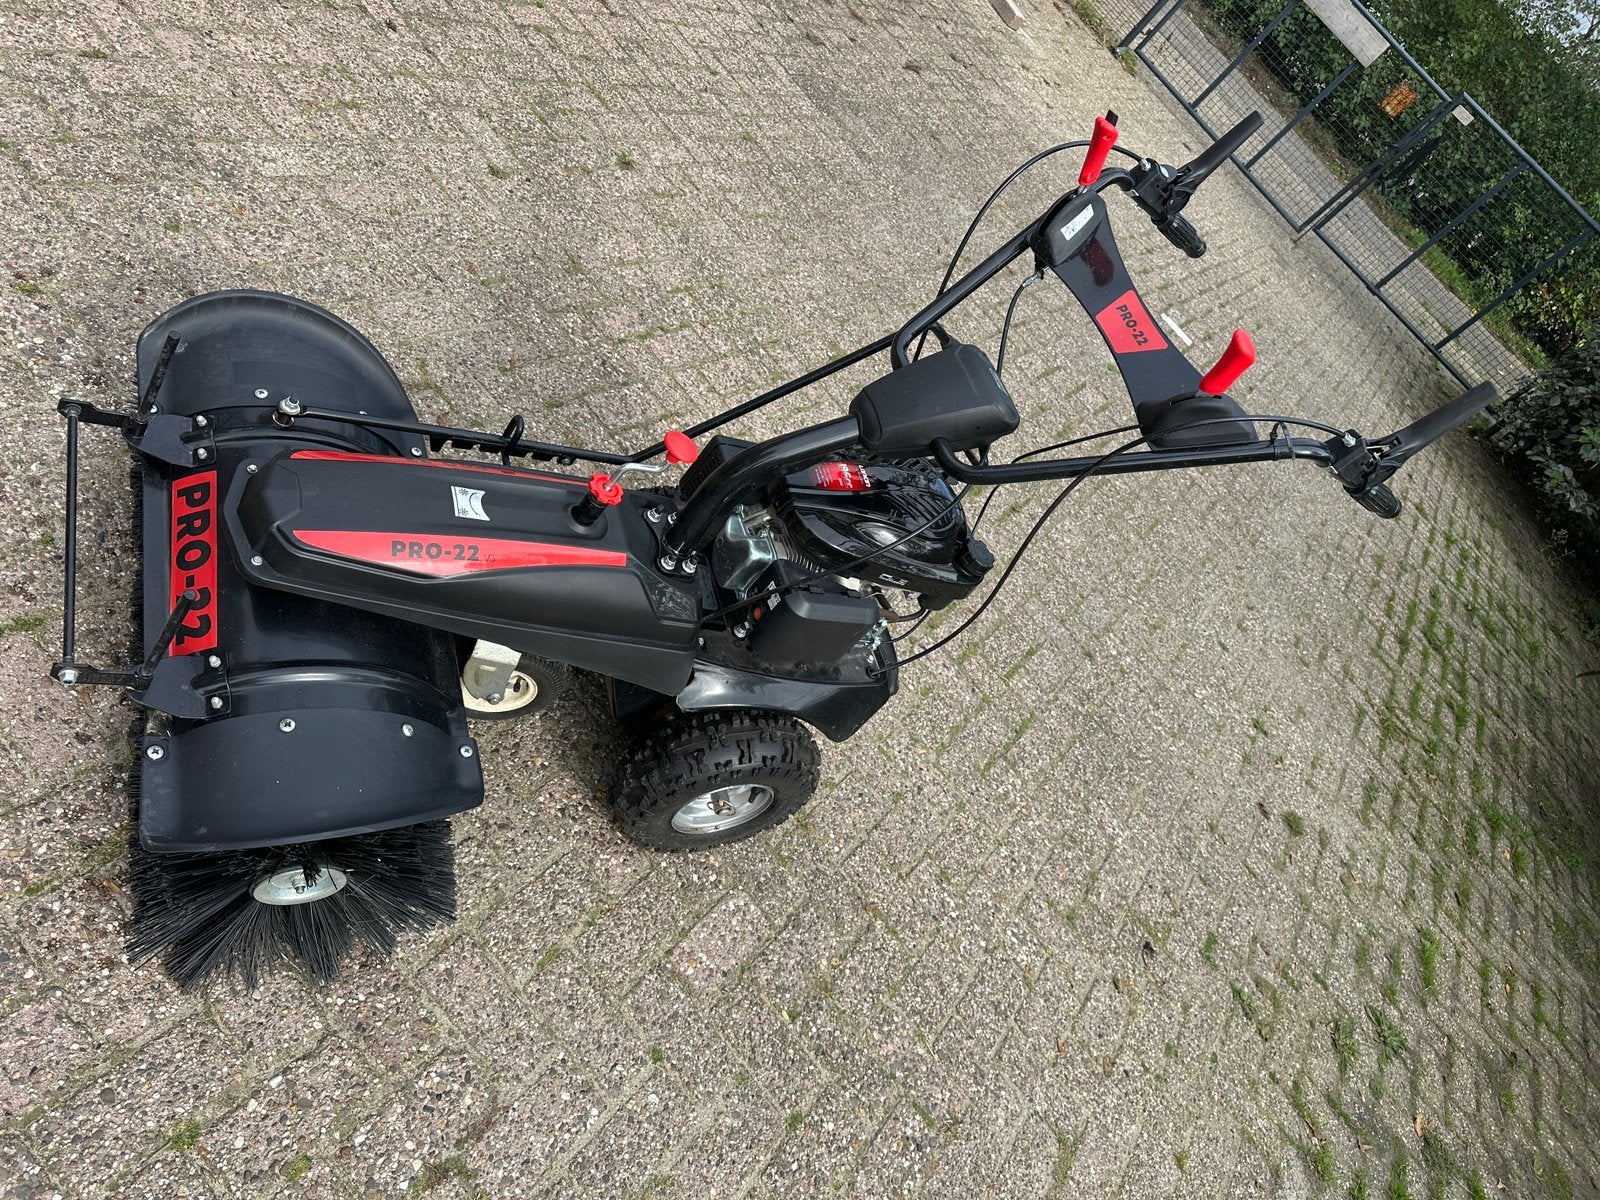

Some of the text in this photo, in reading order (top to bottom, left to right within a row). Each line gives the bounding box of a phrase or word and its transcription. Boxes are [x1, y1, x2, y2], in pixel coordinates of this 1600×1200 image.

[1116, 304, 1148, 346] PRO-22
[176, 481, 212, 647] PRO-22
[391, 540, 479, 562] PRO-22
